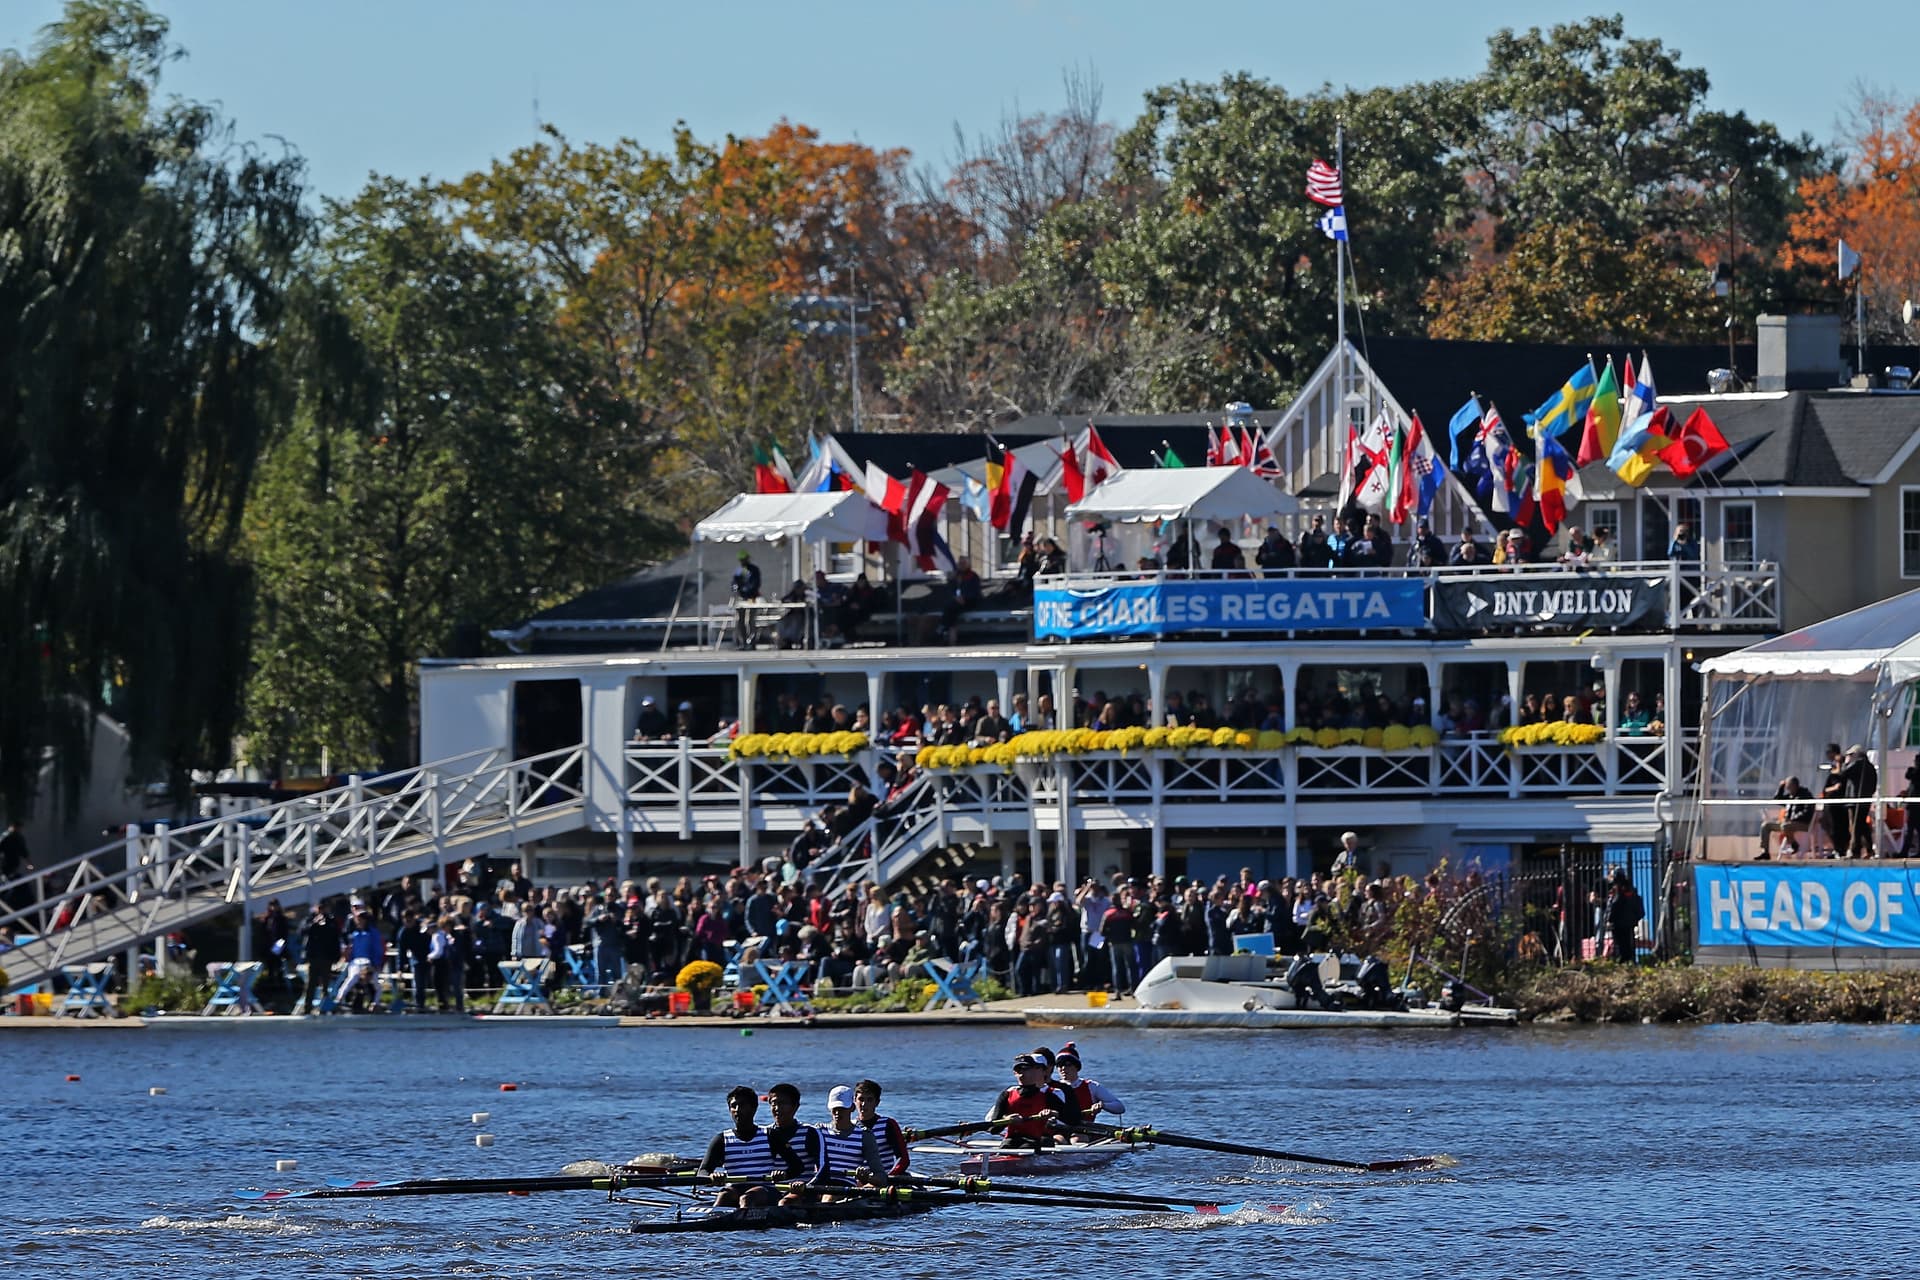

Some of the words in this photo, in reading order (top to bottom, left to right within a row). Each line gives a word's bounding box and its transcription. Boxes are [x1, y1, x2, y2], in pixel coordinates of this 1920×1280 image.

[1081, 595, 1208, 627] CHARLES
[1222, 591, 1391, 622] REGATTA
[1493, 591, 1537, 616] BNY
[1541, 589, 1633, 615] MELLON
[1710, 880, 1831, 931] HEAD
[1844, 881, 1904, 932] OF
